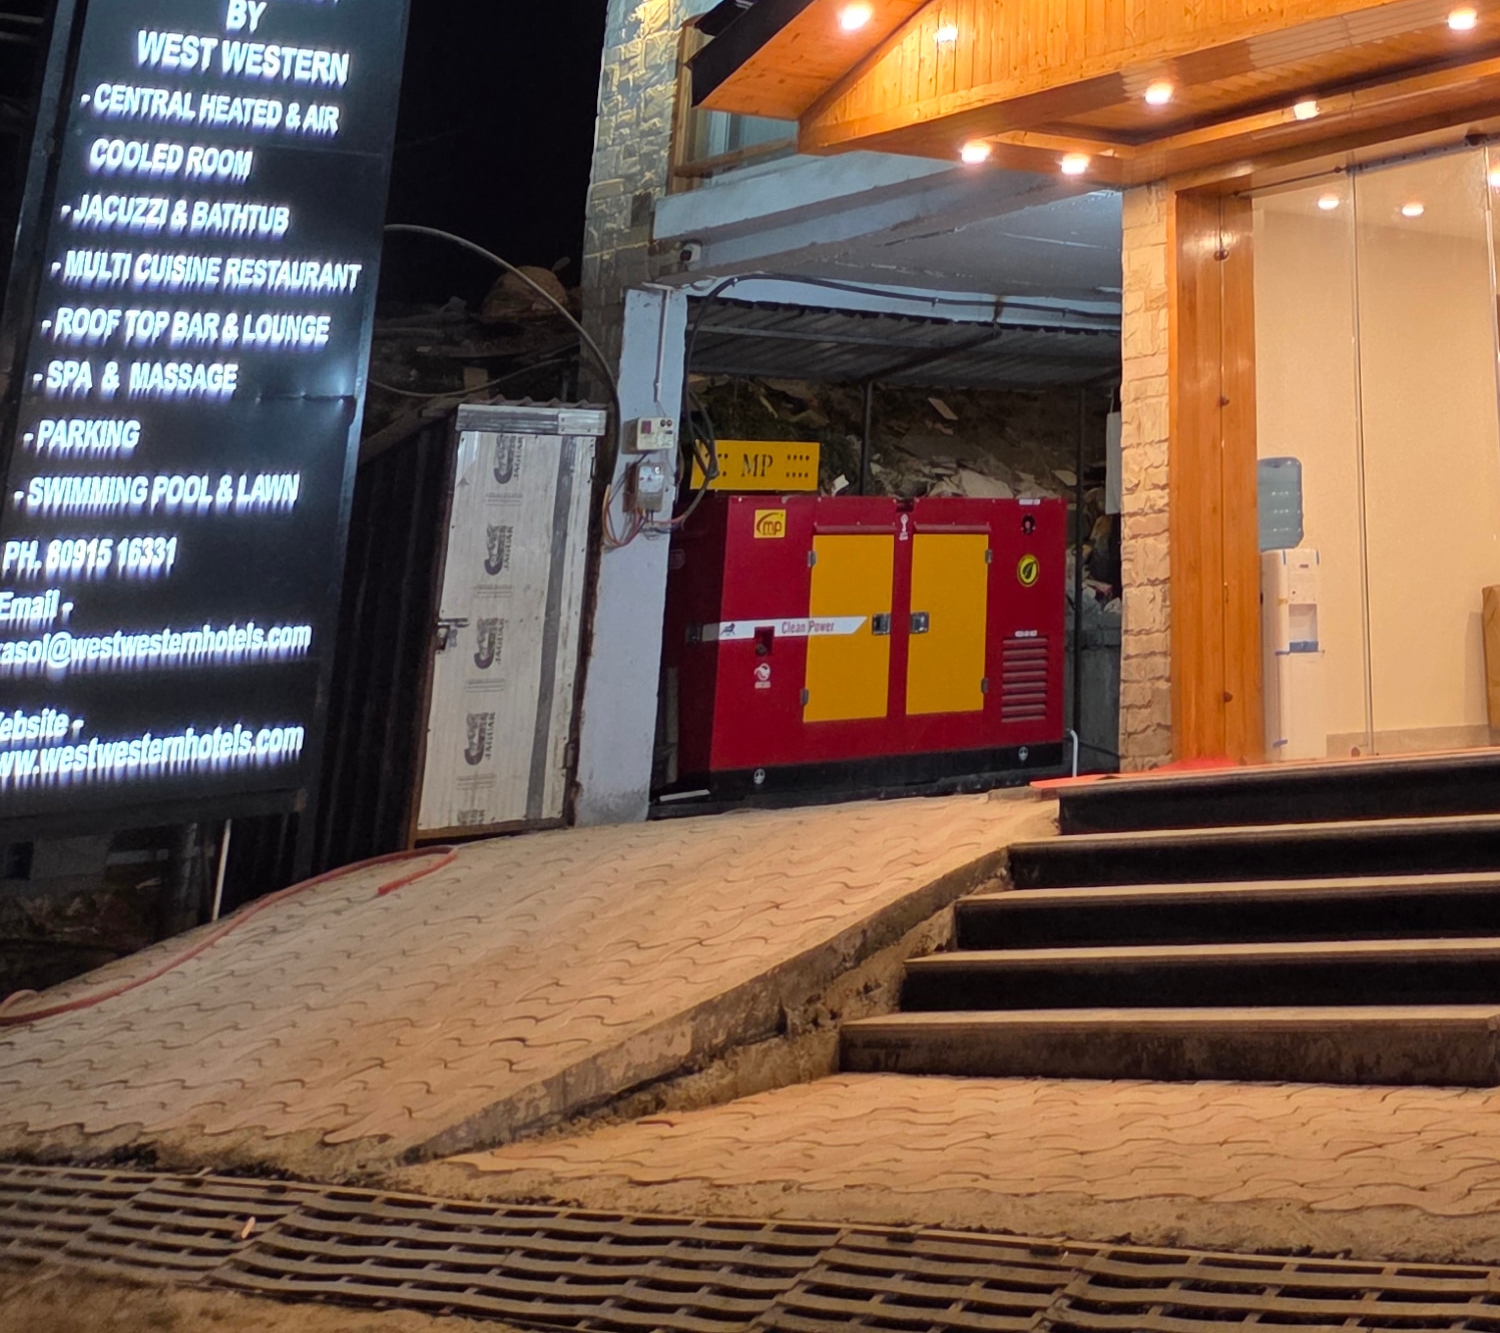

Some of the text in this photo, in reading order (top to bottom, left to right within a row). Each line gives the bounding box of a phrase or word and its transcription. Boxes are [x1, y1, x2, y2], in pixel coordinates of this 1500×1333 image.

[136, 30, 351, 88] WEST WESTERN
[93, 83, 197, 121] CENTRAL
[199, 93, 283, 129] HEATED
[285, 102, 302, 130] &
[302, 104, 341, 134] AIR
[88, 138, 254, 182] COOLED ROOM
[72, 193, 168, 229] JACUZZI
[174, 200, 188, 228] &
[191, 201, 290, 236] BATHTUB
[63, 250, 133, 283] MULTI
[134, 253, 220, 288] CUISINE
[223, 258, 362, 293] RESTAURANT
[55, 307, 122, 339] ROOF
[124, 309, 171, 341] TOP
[171, 311, 221, 341] BAR
[222, 313, 240, 342] &
[242, 314, 332, 344] LOUNGE
[46, 360, 93, 390] SPA
[101, 361, 120, 390] &
[129, 362, 239, 392] MASSAGE
[36, 419, 141, 451] PARKING
[741, 453, 774, 477] MP
[27, 475, 149, 509] SWIMMING
[150, 474, 214, 508] POOL
[216, 473, 233, 504] &
[237, 473, 301, 505] LAWN
[2, 536, 178, 573] PH. 80915 16331
[0, 589, 61, 622] Email
[781, 619, 835, 634] Clean Power
[0, 622, 312, 669] asol@westwesternhotels.com
[0, 707, 70, 743] ebsite
